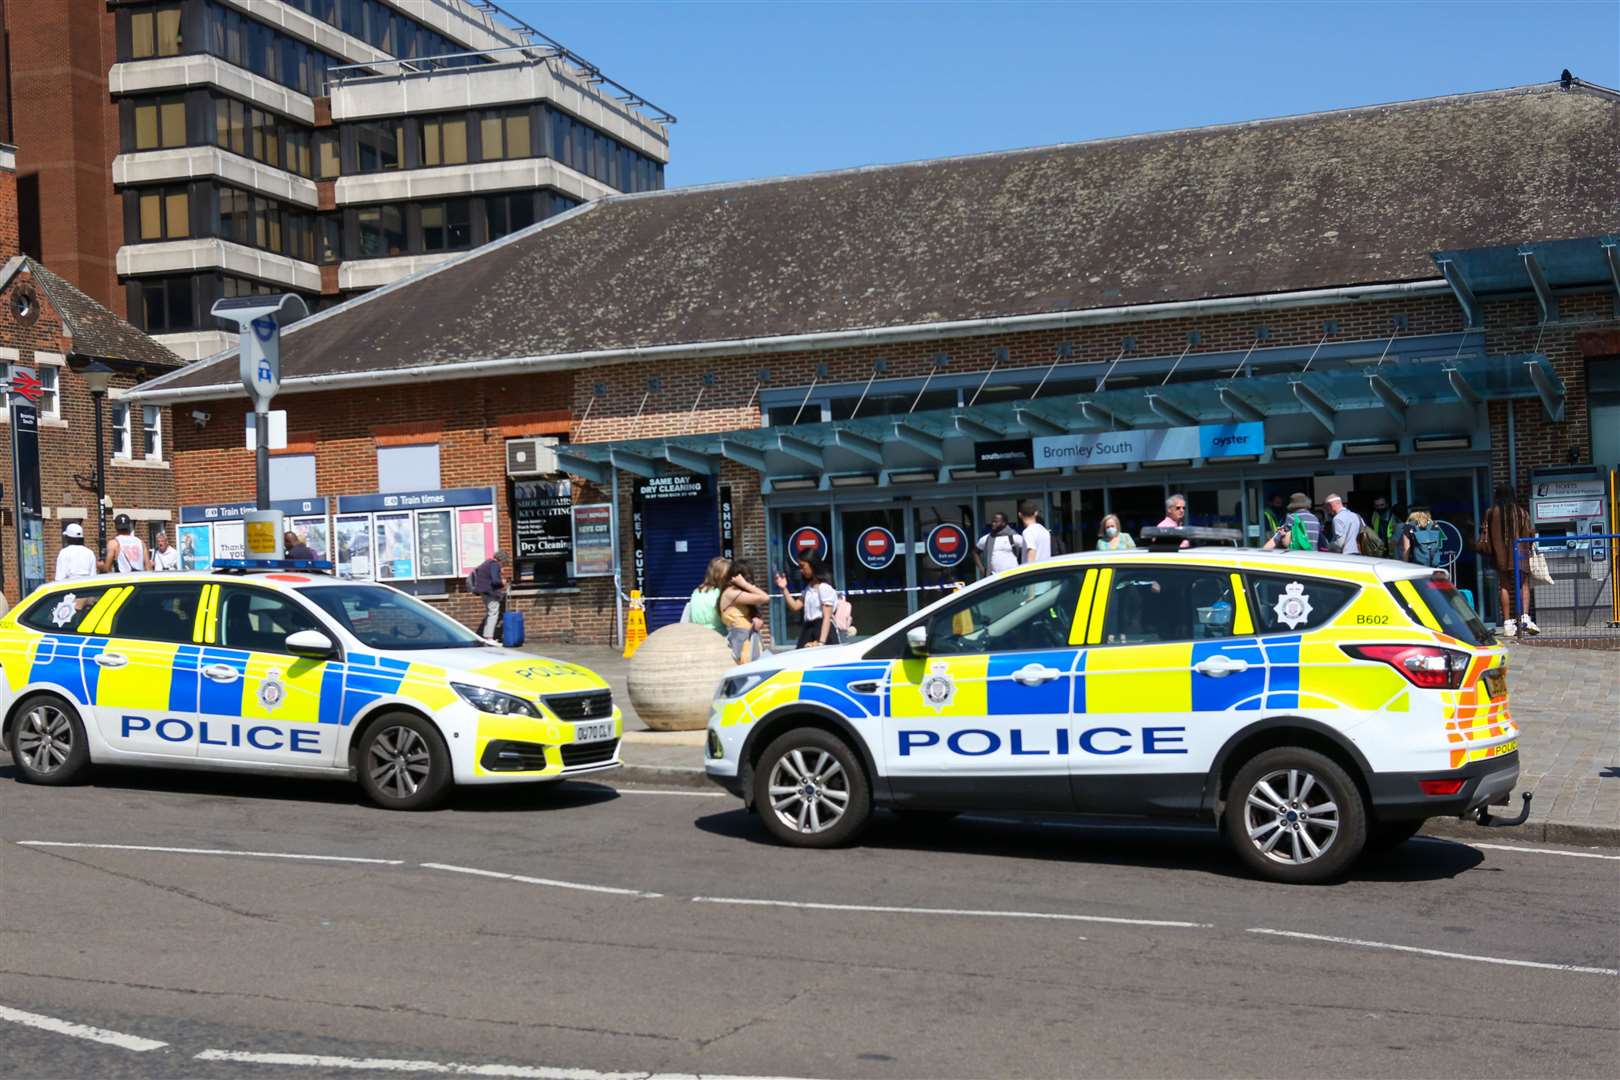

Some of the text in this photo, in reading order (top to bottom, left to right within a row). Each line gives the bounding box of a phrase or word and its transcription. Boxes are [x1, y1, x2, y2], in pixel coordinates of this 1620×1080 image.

[1212, 435, 1248, 447] oyster
[1044, 441, 1132, 458] Bromley South
[649, 476, 690, 486] SAME DAY
[640, 482, 701, 494] DRY CLEANING
[400, 494, 445, 504] Train times
[220, 507, 239, 516] Train
[633, 512, 641, 539] KEY
[723, 503, 732, 539] SHOE
[521, 542, 537, 552] Dry
[1356, 614, 1389, 625] B602
[121, 715, 322, 754] POLICE
[897, 727, 1188, 756] POLICE
